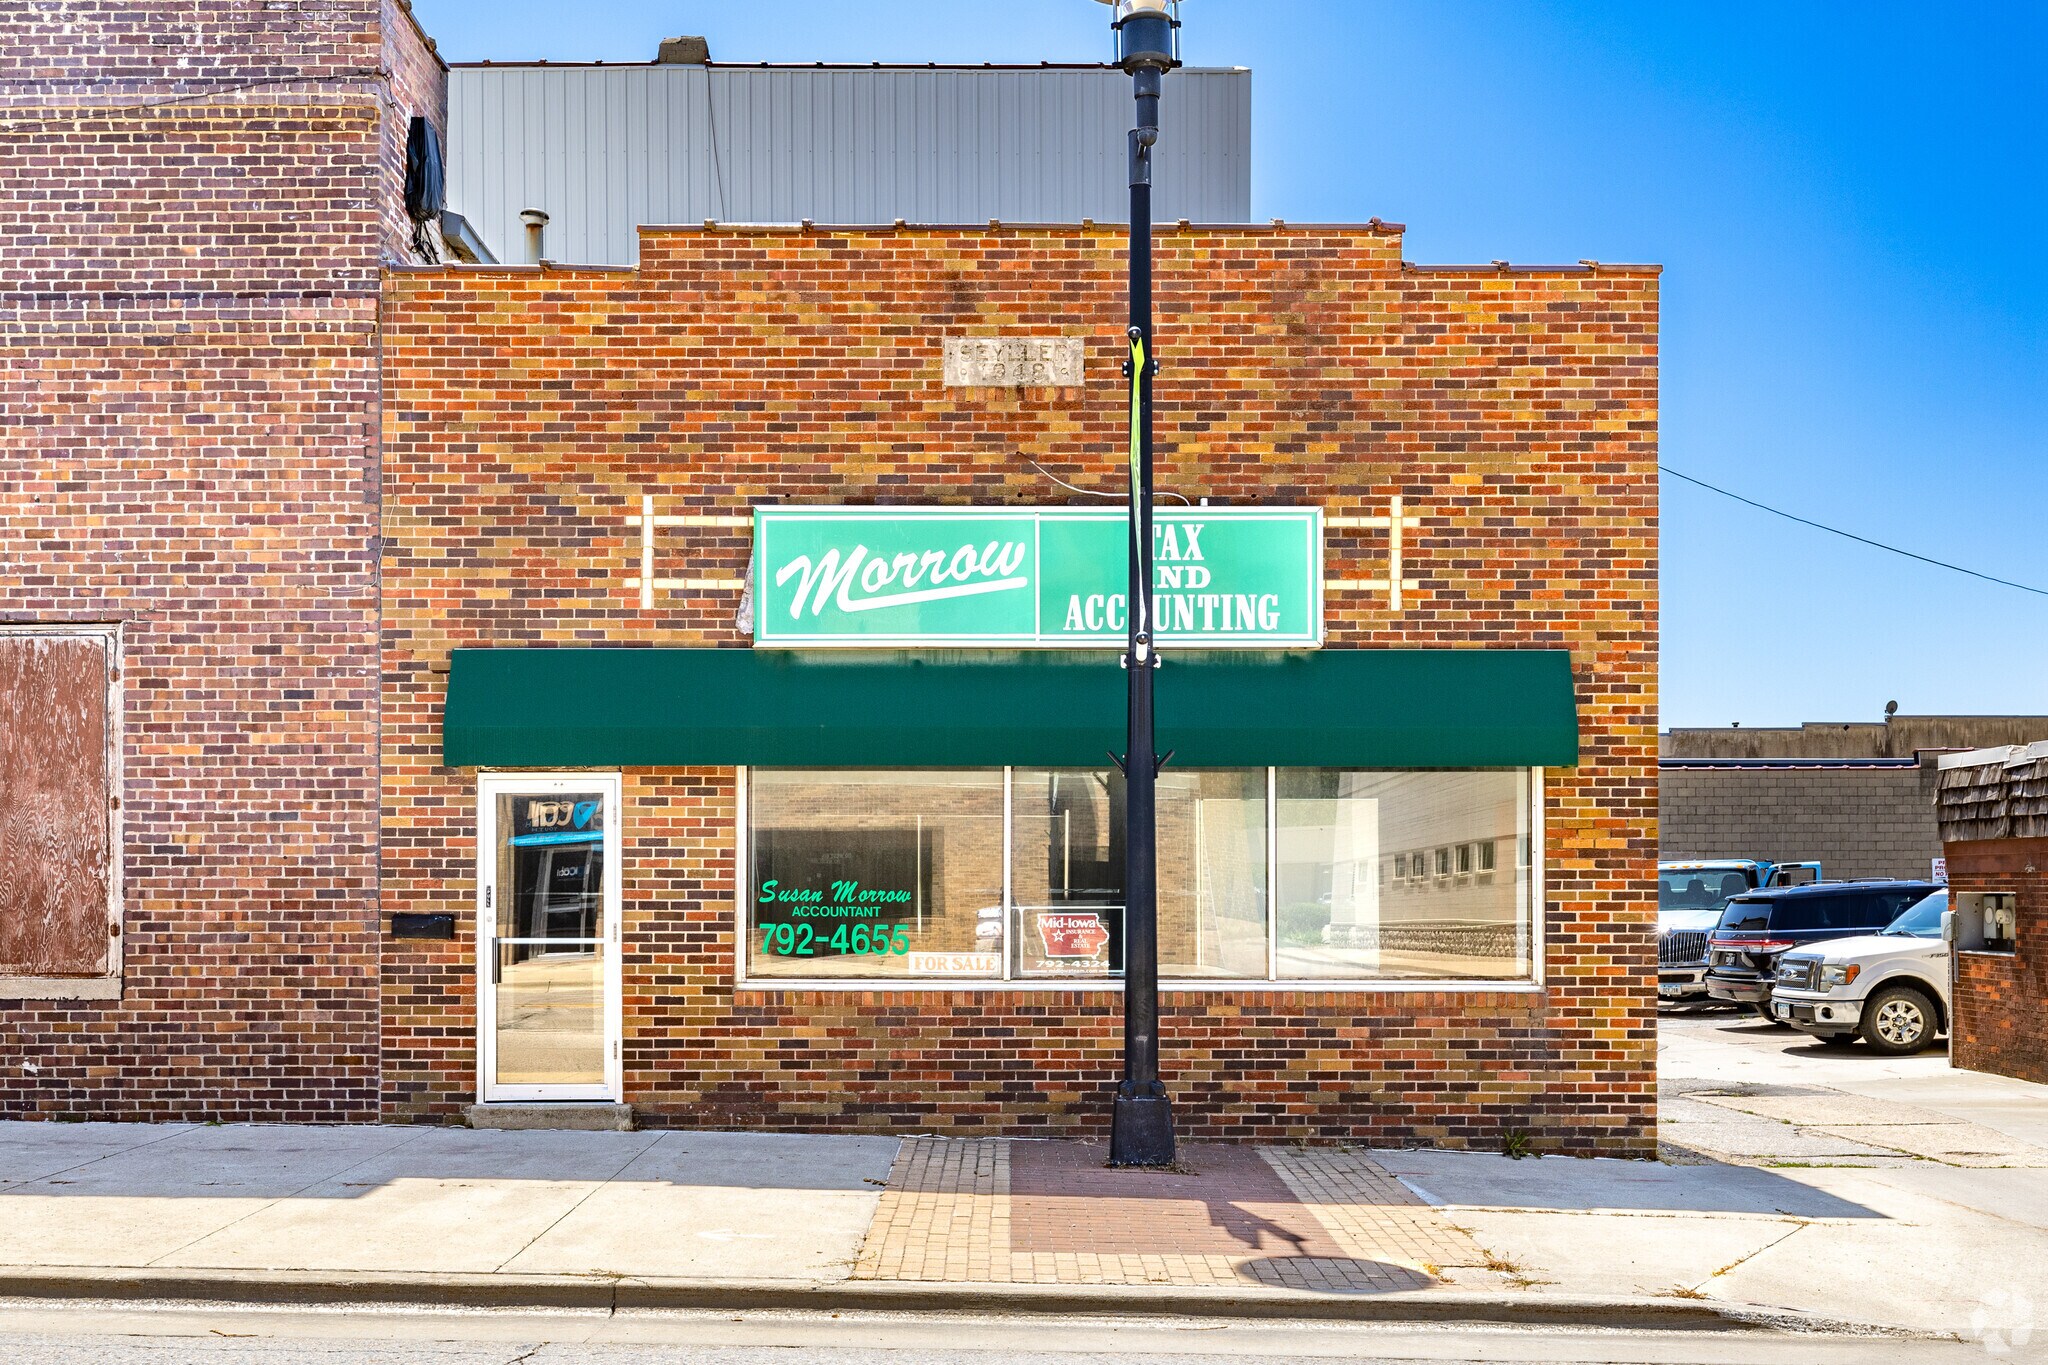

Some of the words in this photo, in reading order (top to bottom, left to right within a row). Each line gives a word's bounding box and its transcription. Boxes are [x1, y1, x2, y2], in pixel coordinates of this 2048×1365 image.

[775, 539, 1027, 620] Morrow
[1152, 565, 1212, 589] ND
[1063, 593, 1281, 632] ACCUNTING
[758, 879, 823, 903] Susan
[831, 879, 912, 903] Morrow
[791, 905, 882, 918] ACCOUNTANT
[1040, 916, 1096, 929] Mid-Iowa
[758, 922, 911, 956] 792-4655
[913, 956, 949, 971] FOR
[951, 956, 998, 972] SALE
[1036, 960, 1110, 968] 792-4324
